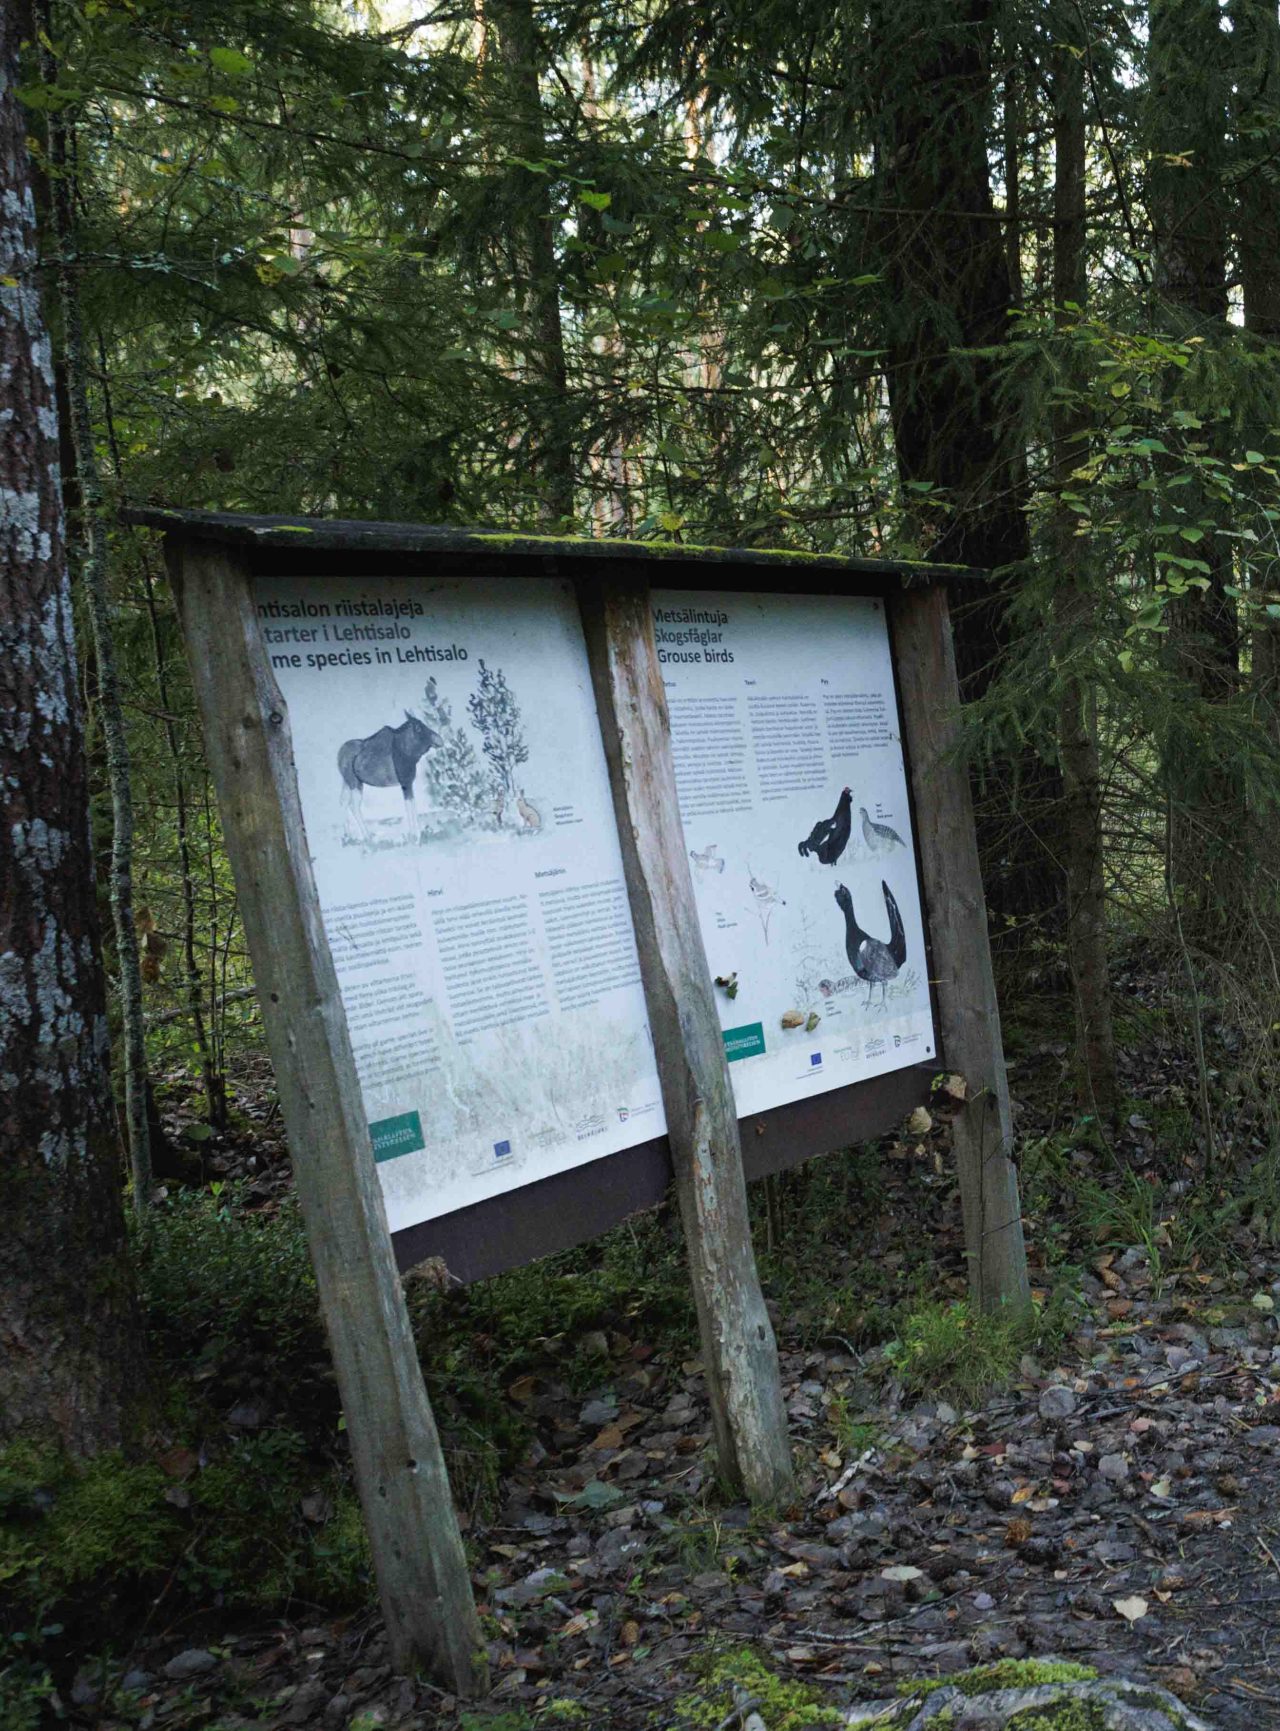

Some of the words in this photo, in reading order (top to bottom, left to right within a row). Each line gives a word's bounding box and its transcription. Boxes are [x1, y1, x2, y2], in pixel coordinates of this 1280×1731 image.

[334, 598, 424, 620] riistalajeja
[263, 626, 318, 644] tarter
[322, 624, 330, 641] i
[333, 622, 411, 641] Lehtisalo
[271, 654, 302, 669] me
[306, 648, 372, 671] species
[375, 647, 392, 665] in
[396, 643, 468, 664] Lehtisalo
[657, 648, 701, 663] Grouse
[703, 648, 734, 663] birds
